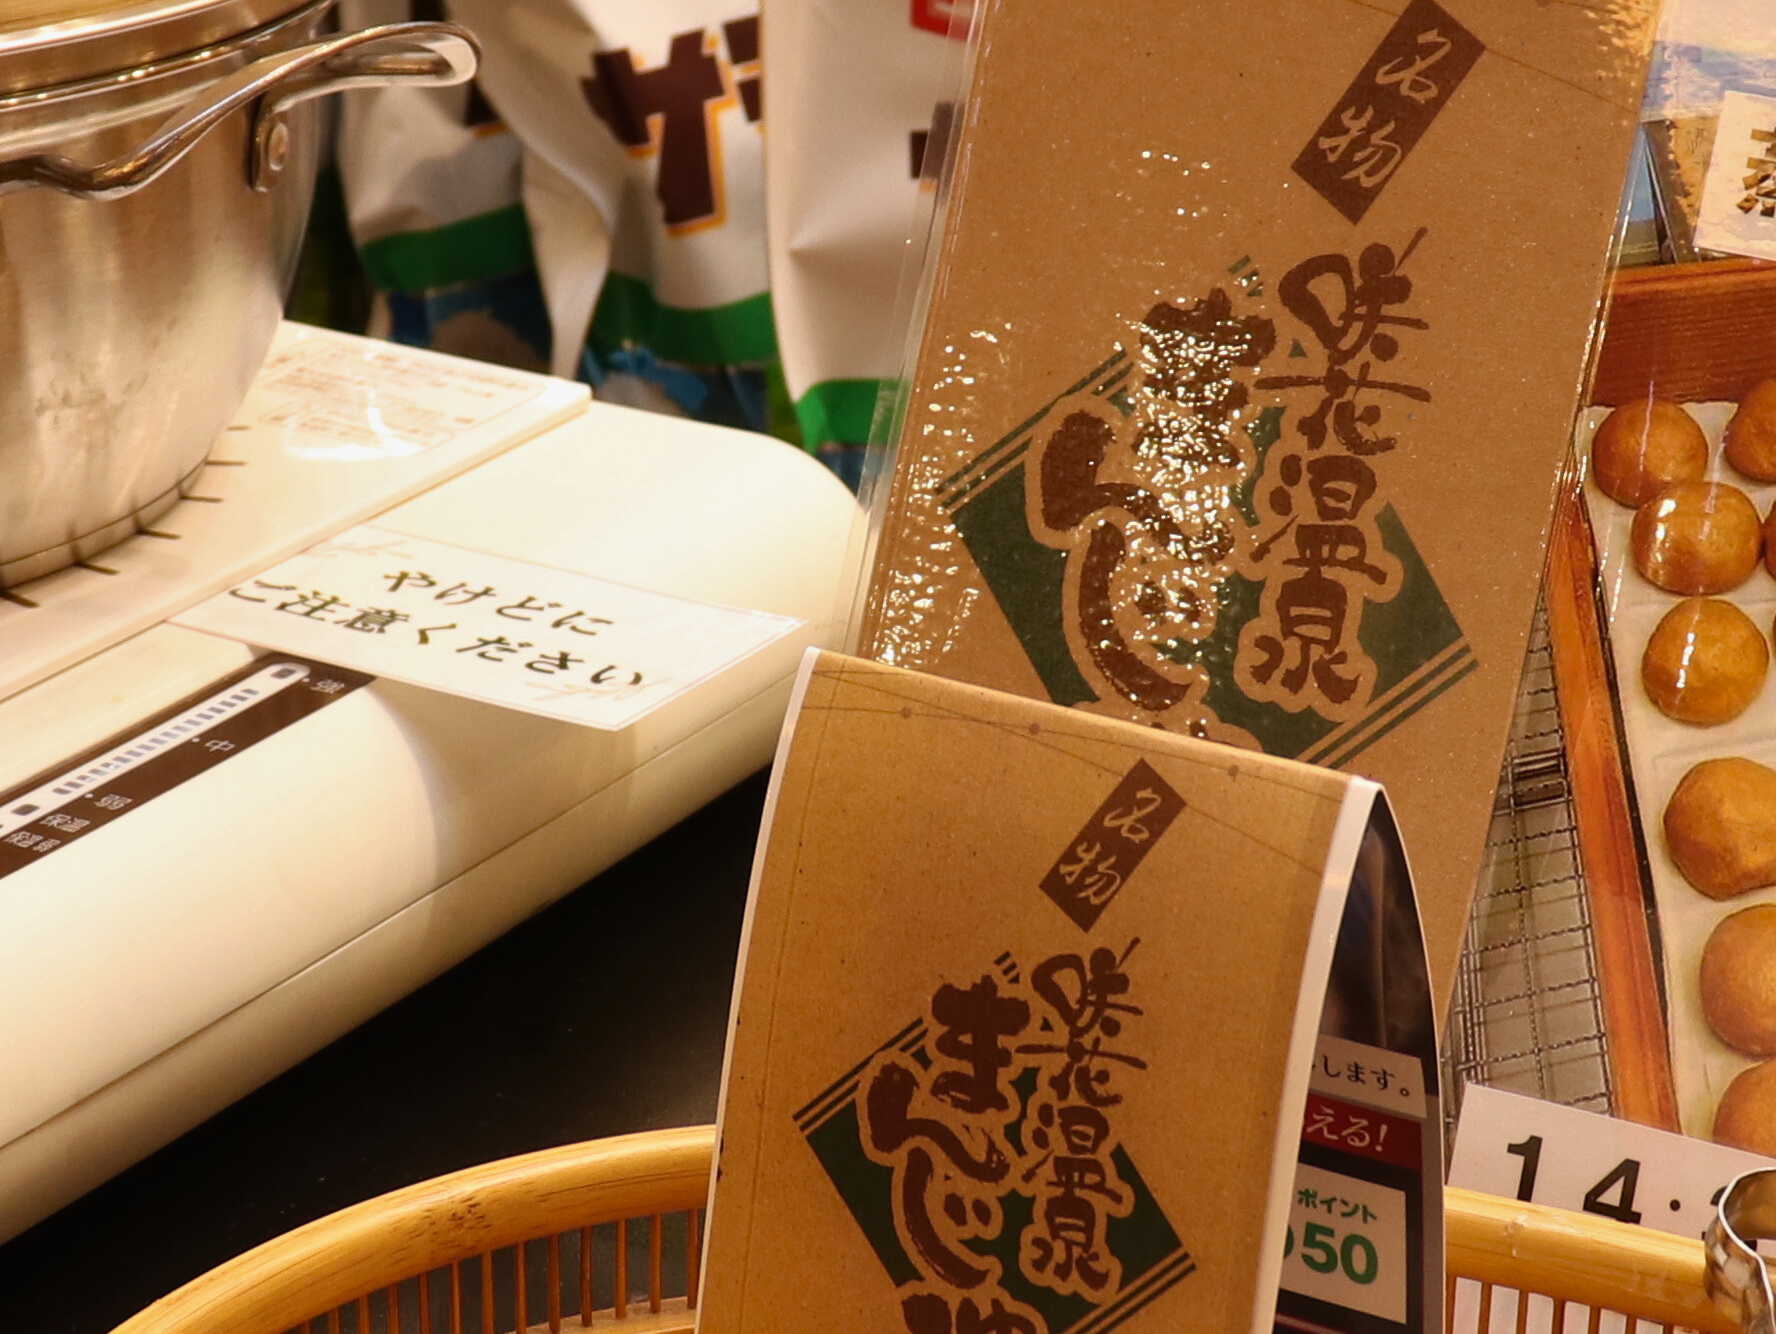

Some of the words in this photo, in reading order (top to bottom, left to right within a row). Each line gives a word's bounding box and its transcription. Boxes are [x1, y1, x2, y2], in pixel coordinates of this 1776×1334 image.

[1318, 29, 1455, 192] 名物
[227, 578, 643, 688] ご注意ください
[383, 570, 615, 636] やけどに
[1057, 785, 1161, 908] 名物
[1312, 1054, 1411, 1098] します。
[1306, 1104, 1389, 1153] える!
[1297, 1187, 1378, 1225] ポイント
